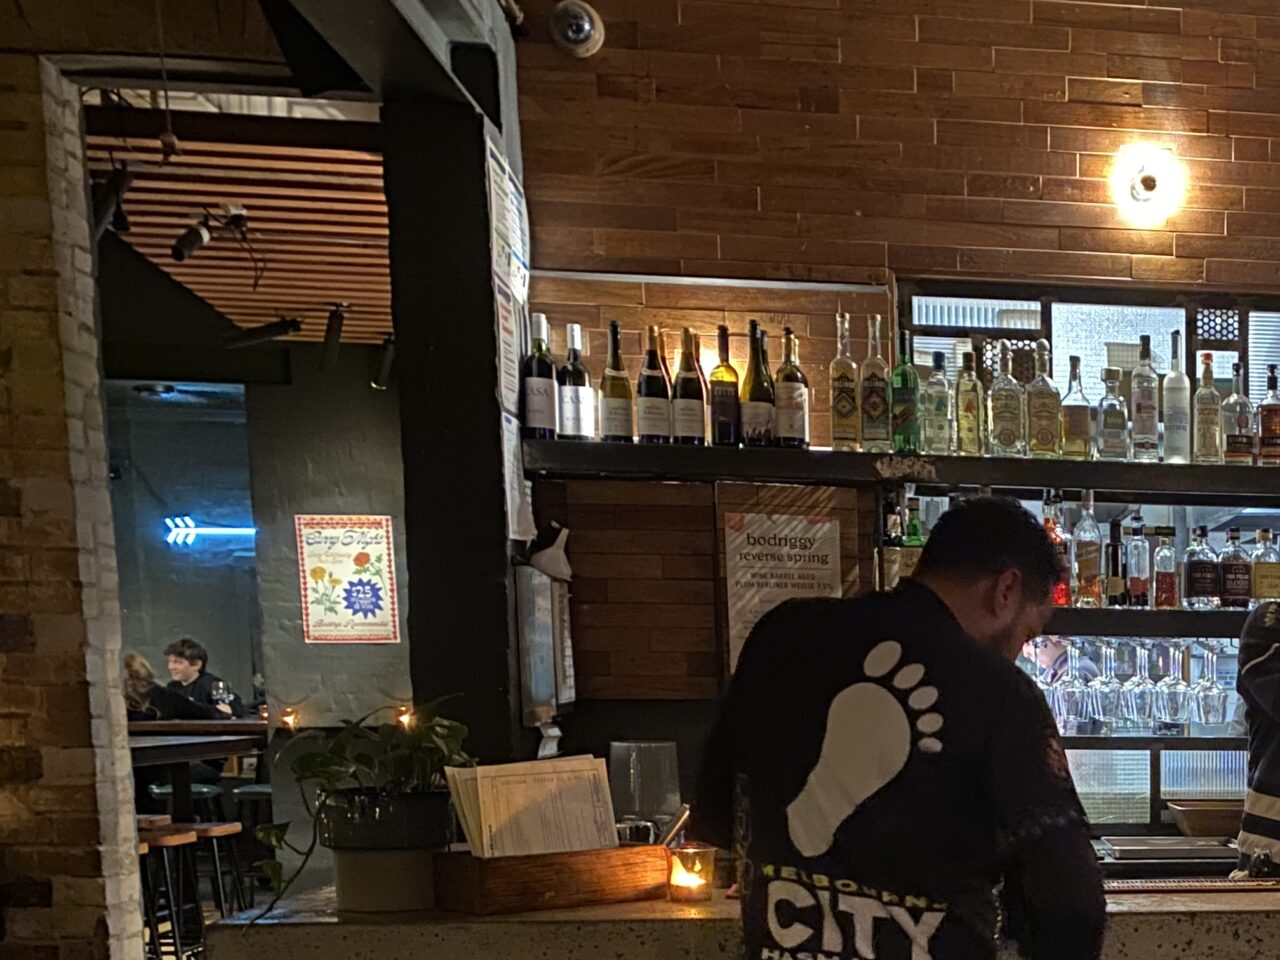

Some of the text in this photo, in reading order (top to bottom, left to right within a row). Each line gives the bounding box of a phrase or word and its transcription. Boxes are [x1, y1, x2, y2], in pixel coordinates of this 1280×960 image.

[746, 532, 816, 550] bodriggy
[739, 552, 830, 566] reverse spring
[770, 572, 795, 581] BARREL
[798, 573, 816, 581] AGED
[351, 585, 373, 598] $25
